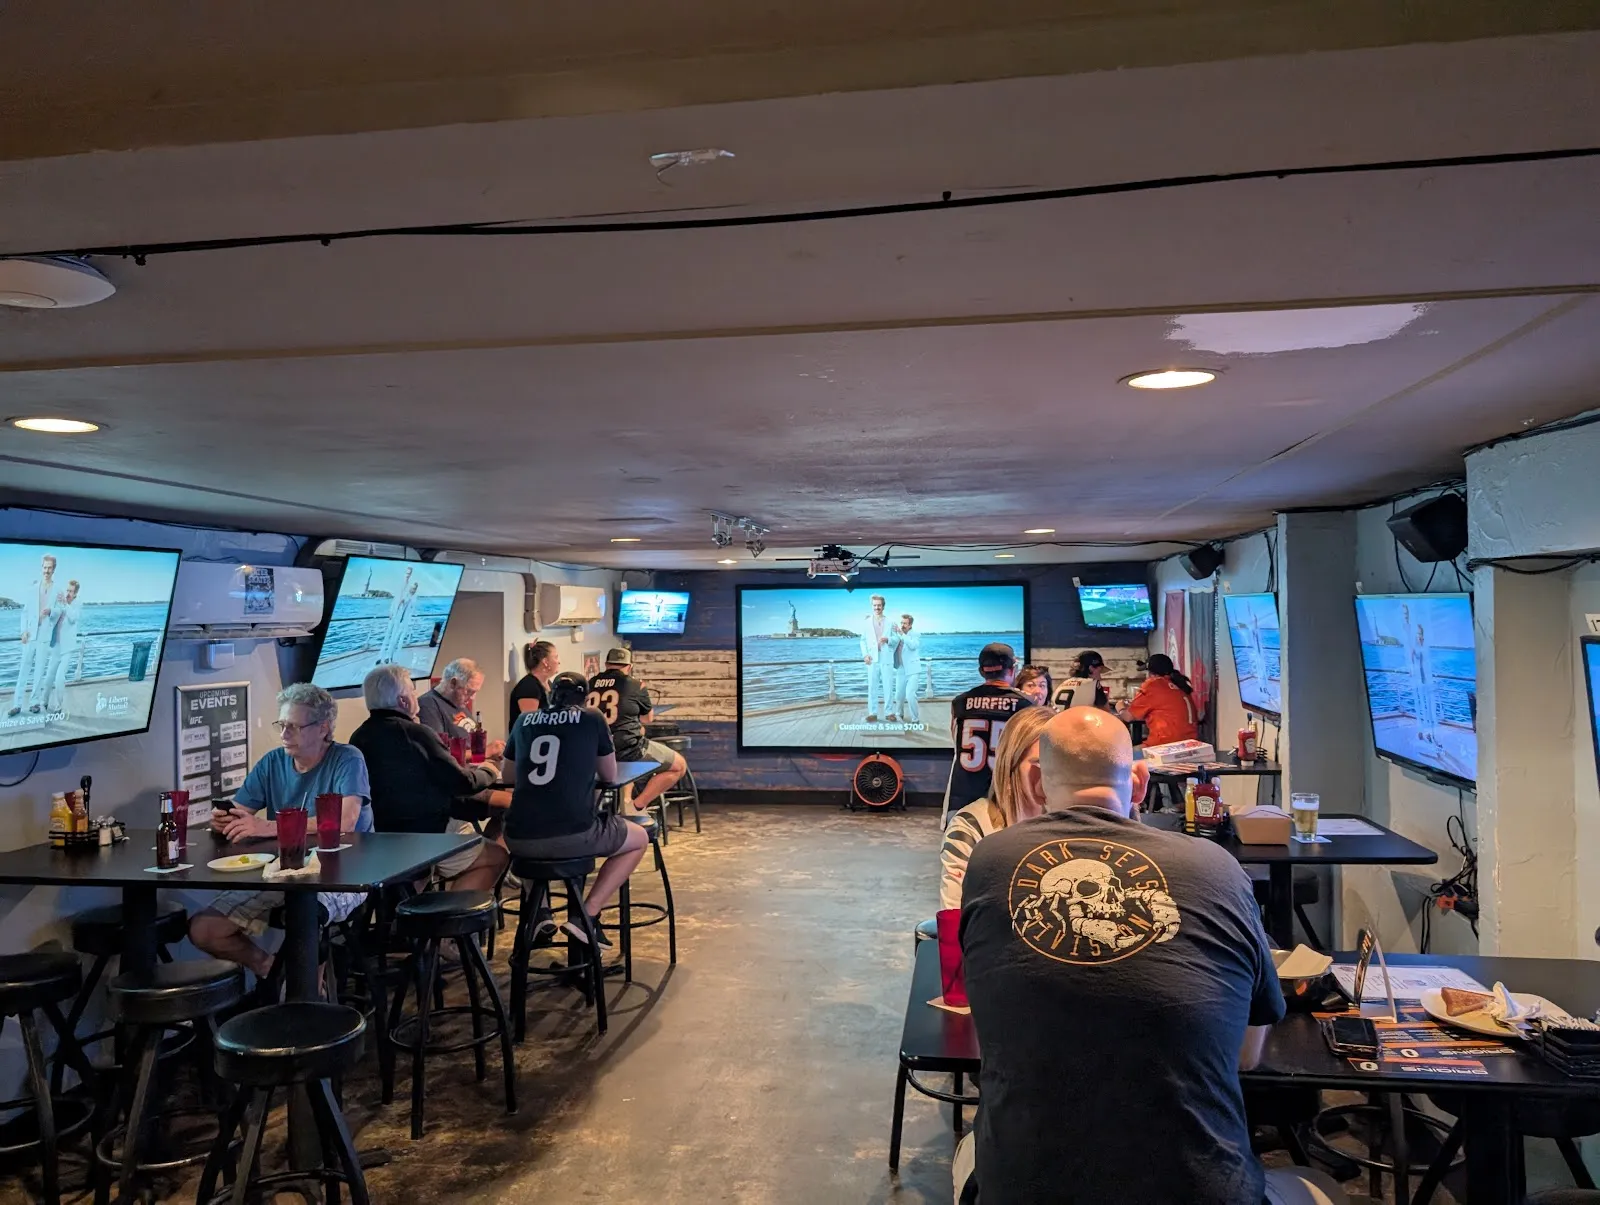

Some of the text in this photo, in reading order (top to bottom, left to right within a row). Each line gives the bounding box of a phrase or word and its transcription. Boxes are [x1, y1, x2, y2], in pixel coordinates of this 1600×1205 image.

[594, 679, 616, 688] BOYD
[200, 689, 230, 699] UPCOMING
[190, 695, 237, 711] EVENTS
[966, 697, 1019, 712] BURFICT
[27, 716, 44, 725] Save
[45, 712, 65, 723] $700
[190, 716, 203, 725] UFC
[523, 710, 581, 727] BURROW
[839, 723, 877, 731] Customize
[885, 723, 903, 731] Save
[903, 723, 924, 732] $700
[527, 735, 561, 786] 9
[1017, 842, 1159, 890] DARK SEAS
[1027, 912, 1152, 956] DIVISON
[1401, 1065, 1489, 1075] ORIGINS
